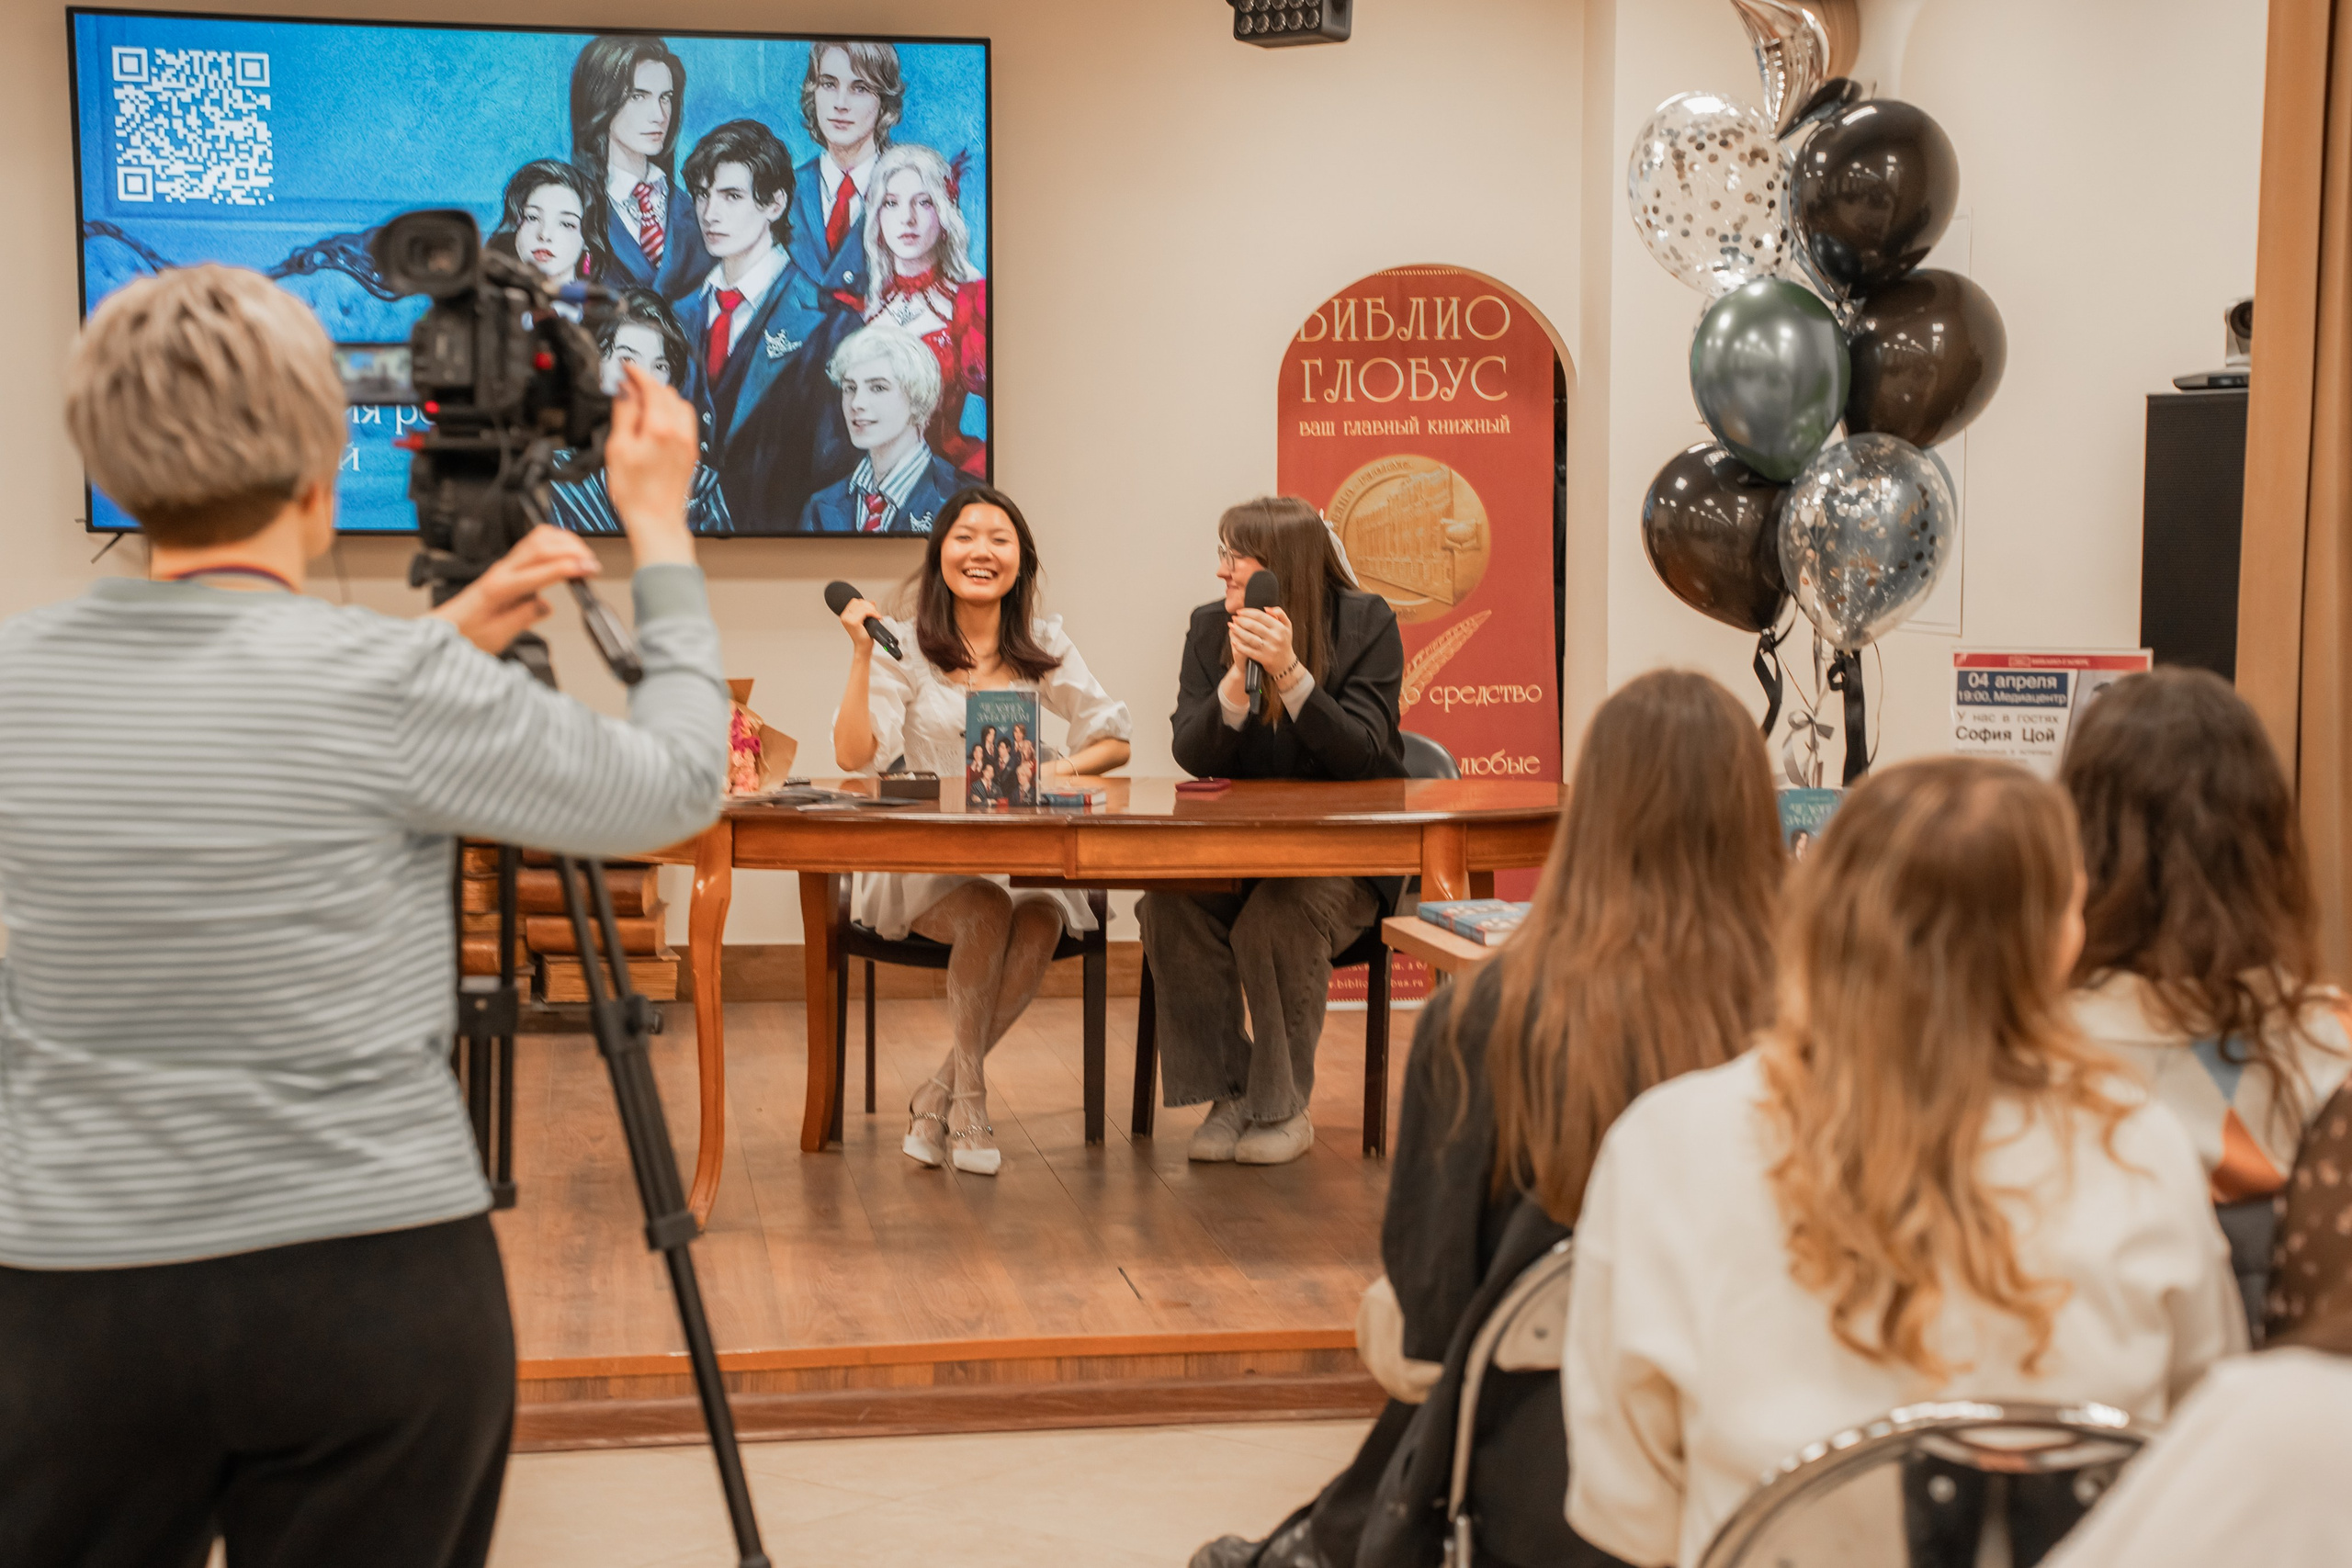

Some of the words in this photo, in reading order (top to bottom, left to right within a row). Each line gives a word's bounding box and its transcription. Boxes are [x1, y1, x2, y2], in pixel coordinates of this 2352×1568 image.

[1296, 295, 1510, 342] БИБЛИО
[1300, 355, 1509, 403] ГЛОБУС
[1298, 421, 1336, 436] ваш
[1343, 415, 1420, 435] главный
[1428, 414, 1511, 434] книжный
[1968, 672, 1989, 688] 04
[1995, 675, 2058, 692] апреля
[1429, 684, 1543, 713] средство
[1993, 691, 2067, 706] Медиацентр
[1957, 710, 1966, 722] У
[1973, 714, 1996, 724] нас
[2002, 714, 2010, 724] в
[2017, 714, 2059, 725] гостях
[1955, 726, 2012, 744] София
[2021, 728, 2056, 745] Цой
[1460, 748, 1541, 775] любые
